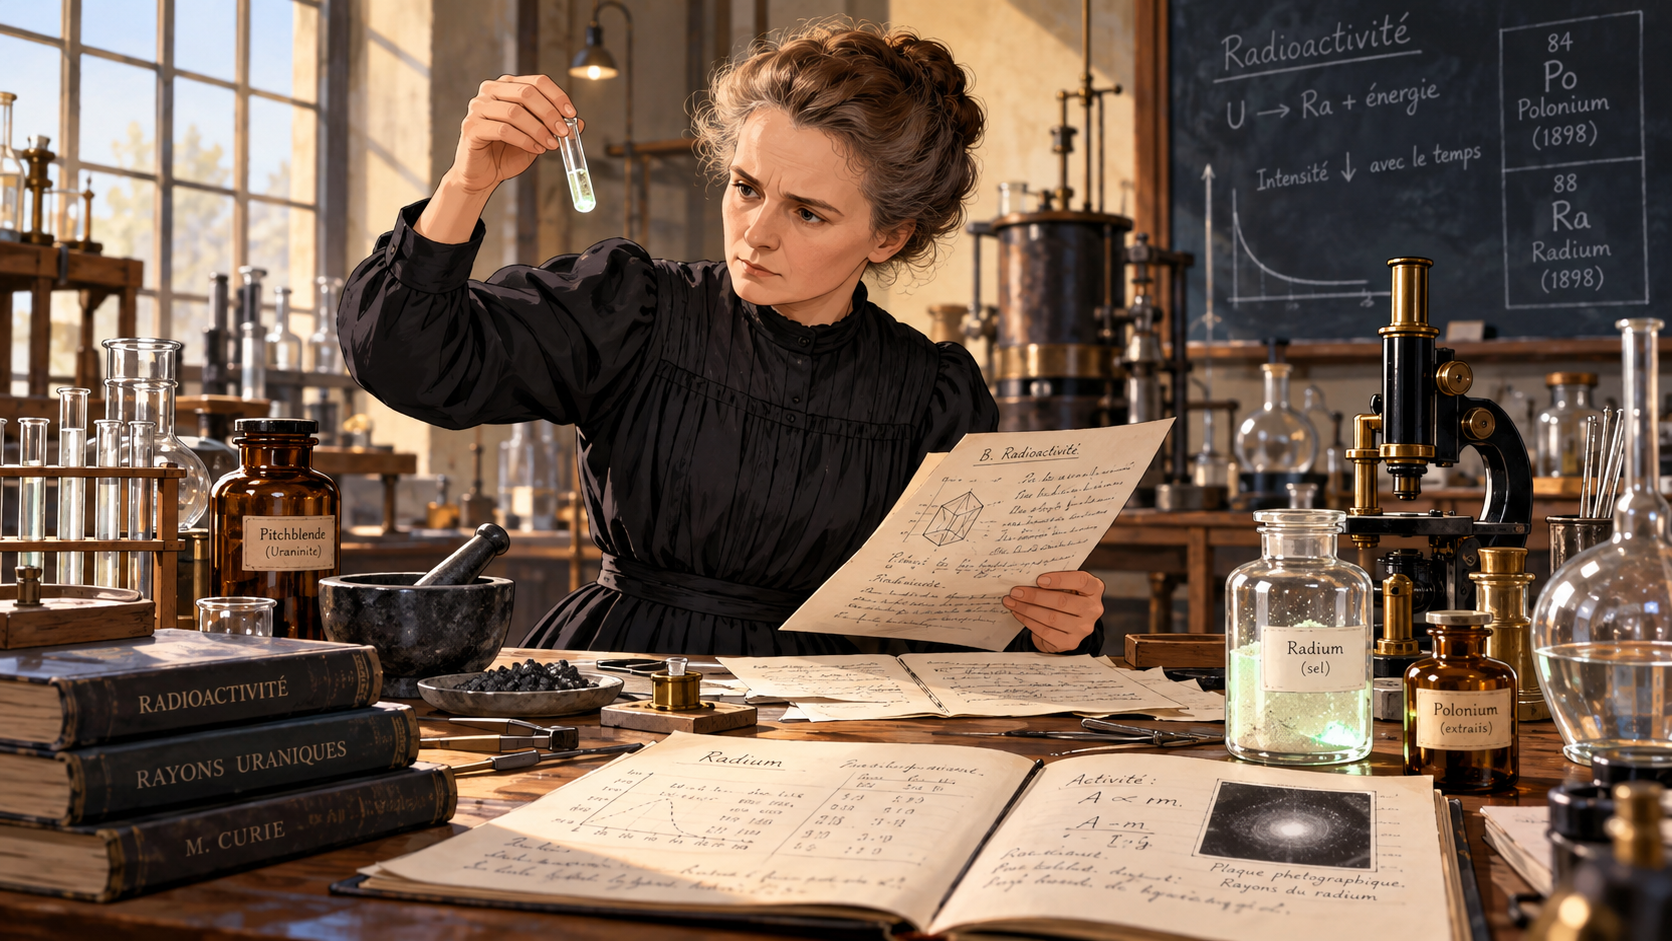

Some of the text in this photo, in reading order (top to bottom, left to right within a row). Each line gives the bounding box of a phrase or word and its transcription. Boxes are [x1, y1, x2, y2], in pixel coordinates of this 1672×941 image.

[1221, 11, 1411, 71] Radioactivité
[1547, 32, 1573, 52] 84
[1543, 60, 1577, 92] Po
[1227, 100, 1245, 129] U
[1301, 89, 1333, 119] Ra
[1366, 78, 1440, 116] énergie
[1518, 96, 1610, 120] Polonium
[1532, 120, 1598, 151] (1898)
[1256, 143, 1482, 191] Intensité avec le temps
[1553, 174, 1578, 193] 88
[1551, 200, 1591, 232] Ra
[1532, 240, 1612, 263] Radium
[1541, 265, 1604, 294] (1898)
[979, 447, 994, 462] B.
[259, 527, 326, 541] Pitchblende
[1287, 640, 1344, 655] Radium
[1301, 660, 1331, 677] (sel)
[138, 675, 289, 715] RADIOACTIVITÉ
[1434, 702, 1498, 717] Polonium
[136, 740, 347, 790] RAYONS URANIQUES
[700, 750, 783, 768] Radium
[1077, 791, 1102, 804] A
[1075, 815, 1100, 829] A
[184, 820, 286, 858] M. CURIE
[1210, 862, 1265, 878] Plaque
[1219, 878, 1378, 901] Rayons du radium
